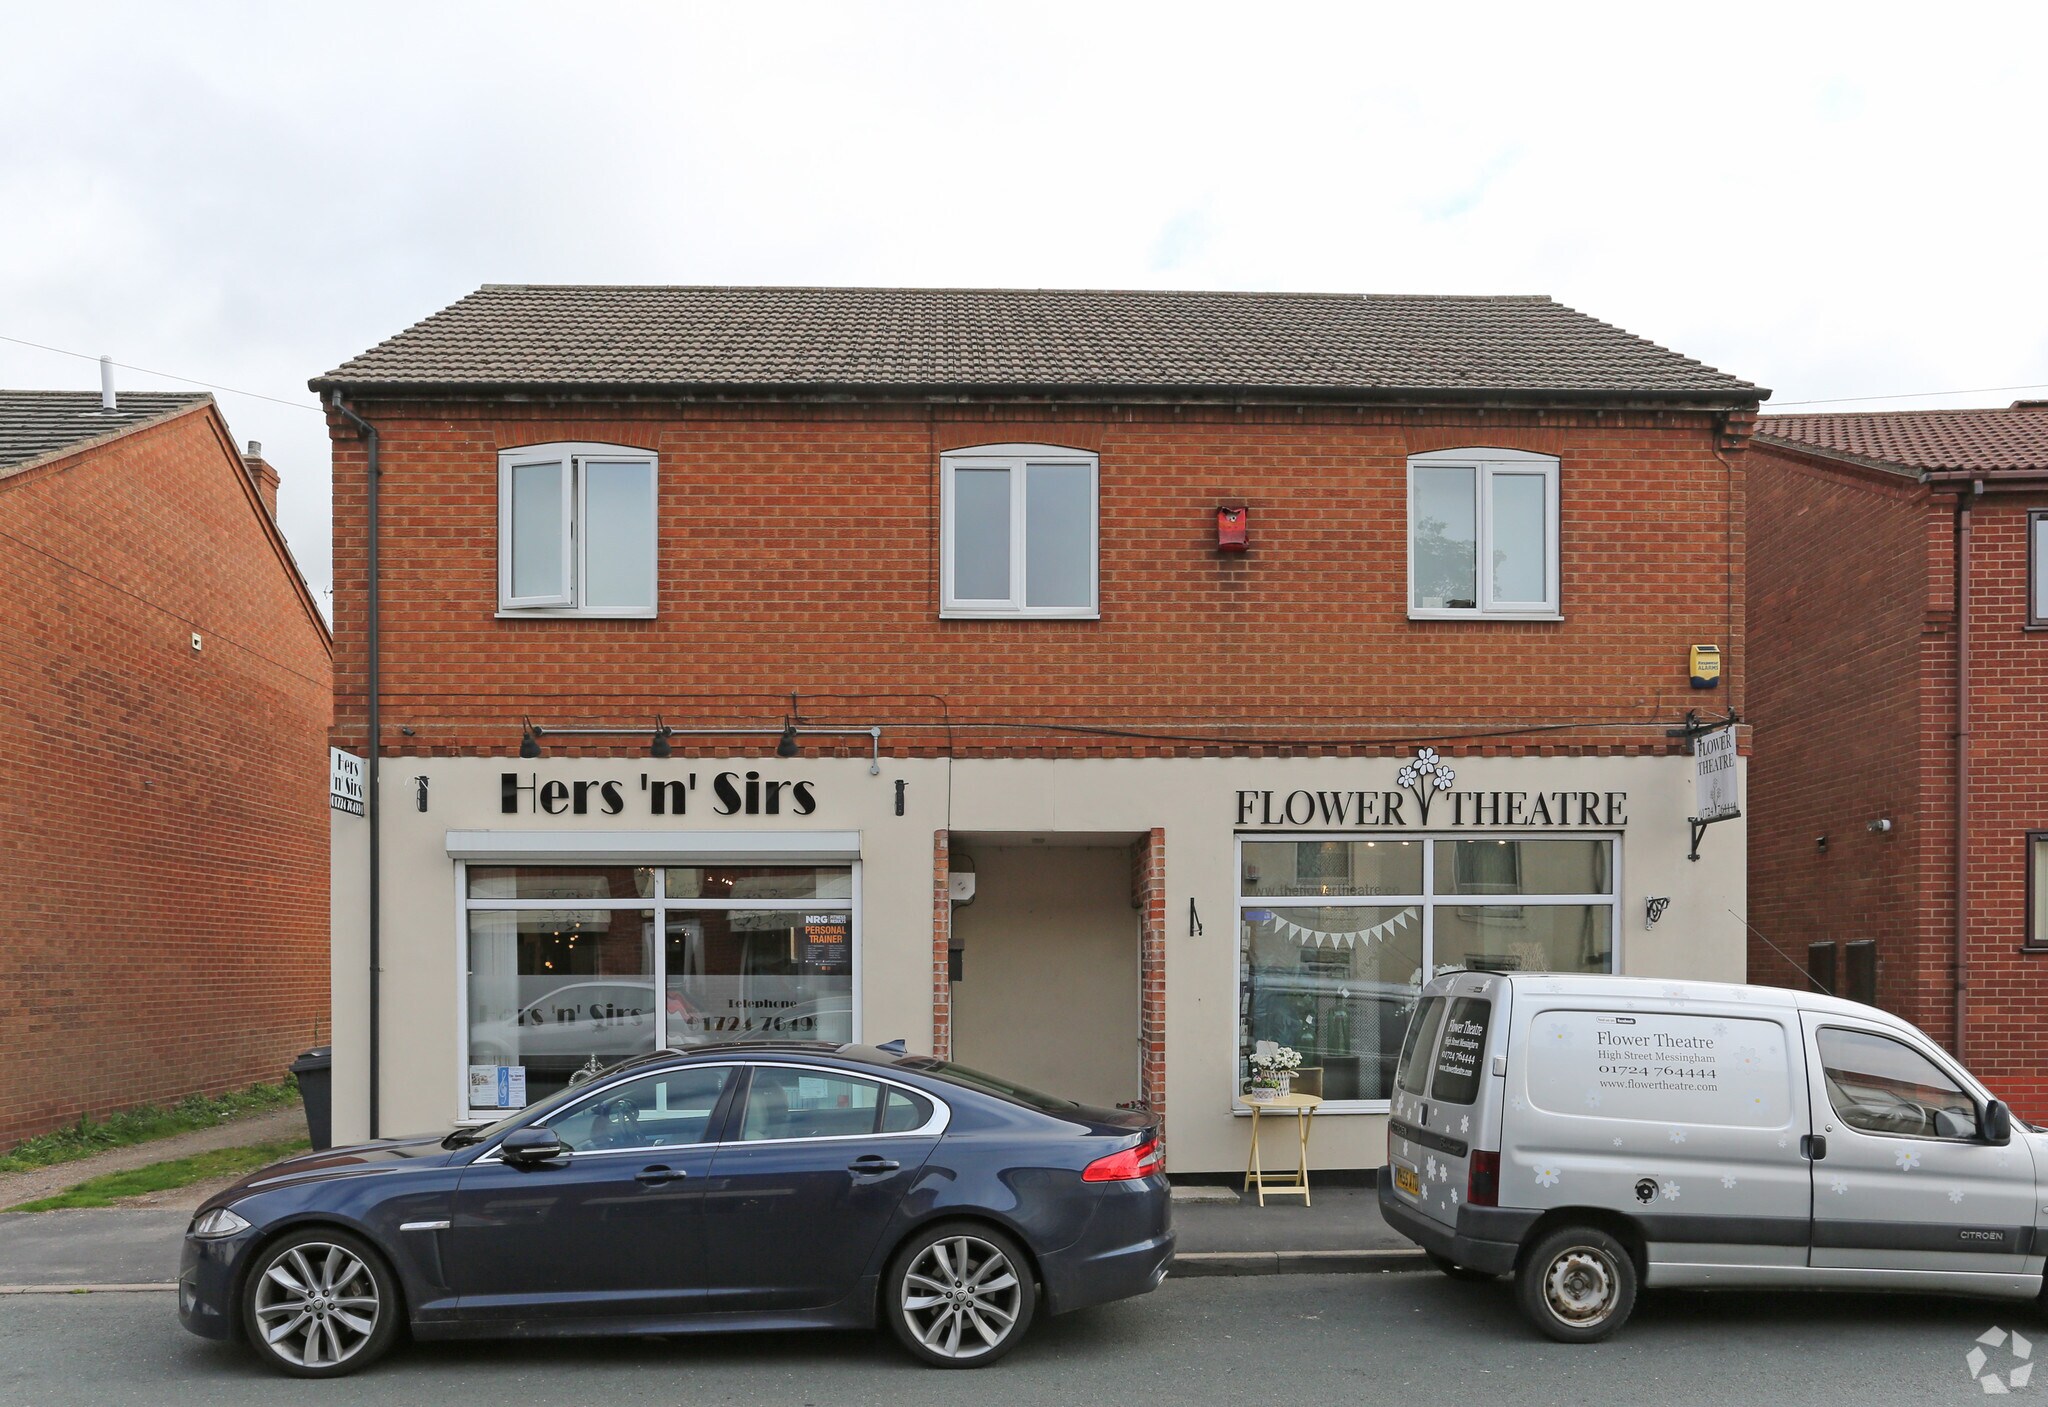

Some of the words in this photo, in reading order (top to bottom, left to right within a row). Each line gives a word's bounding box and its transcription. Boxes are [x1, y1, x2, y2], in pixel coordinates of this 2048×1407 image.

[1698, 734, 1731, 757] FLOWER
[337, 753, 359, 776] Hers
[1697, 753, 1734, 775] THEATRE
[345, 776, 362, 798] Sirs
[501, 772, 624, 815] Hers
[640, 772, 696, 815] 'n'
[713, 771, 816, 816] Sirs
[1234, 789, 1407, 826] FLOWER
[1446, 791, 1628, 826] THEATRE
[805, 915, 828, 924] NRG
[805, 926, 846, 935] PERSONAL
[809, 935, 843, 943] TRAINER
[728, 999, 797, 1009] Telephone
[589, 1003, 643, 1027] Sirs
[1448, 1019, 1464, 1033] Flower
[1463, 1020, 1483, 1036] Theatre
[1597, 1031, 1650, 1047] Flower
[1653, 1033, 1714, 1049] Theatre
[1441, 1050, 1456, 1061] 01724
[1455, 1051, 1475, 1065] 764444
[1598, 1050, 1622, 1061] High
[1624, 1051, 1652, 1061] Street
[1655, 1052, 1716, 1064] Messingham
[1598, 1065, 1648, 1077] 01724
[1653, 1066, 1717, 1079] 764444
[1600, 1079, 1718, 1092] www.flowertheatre.com
